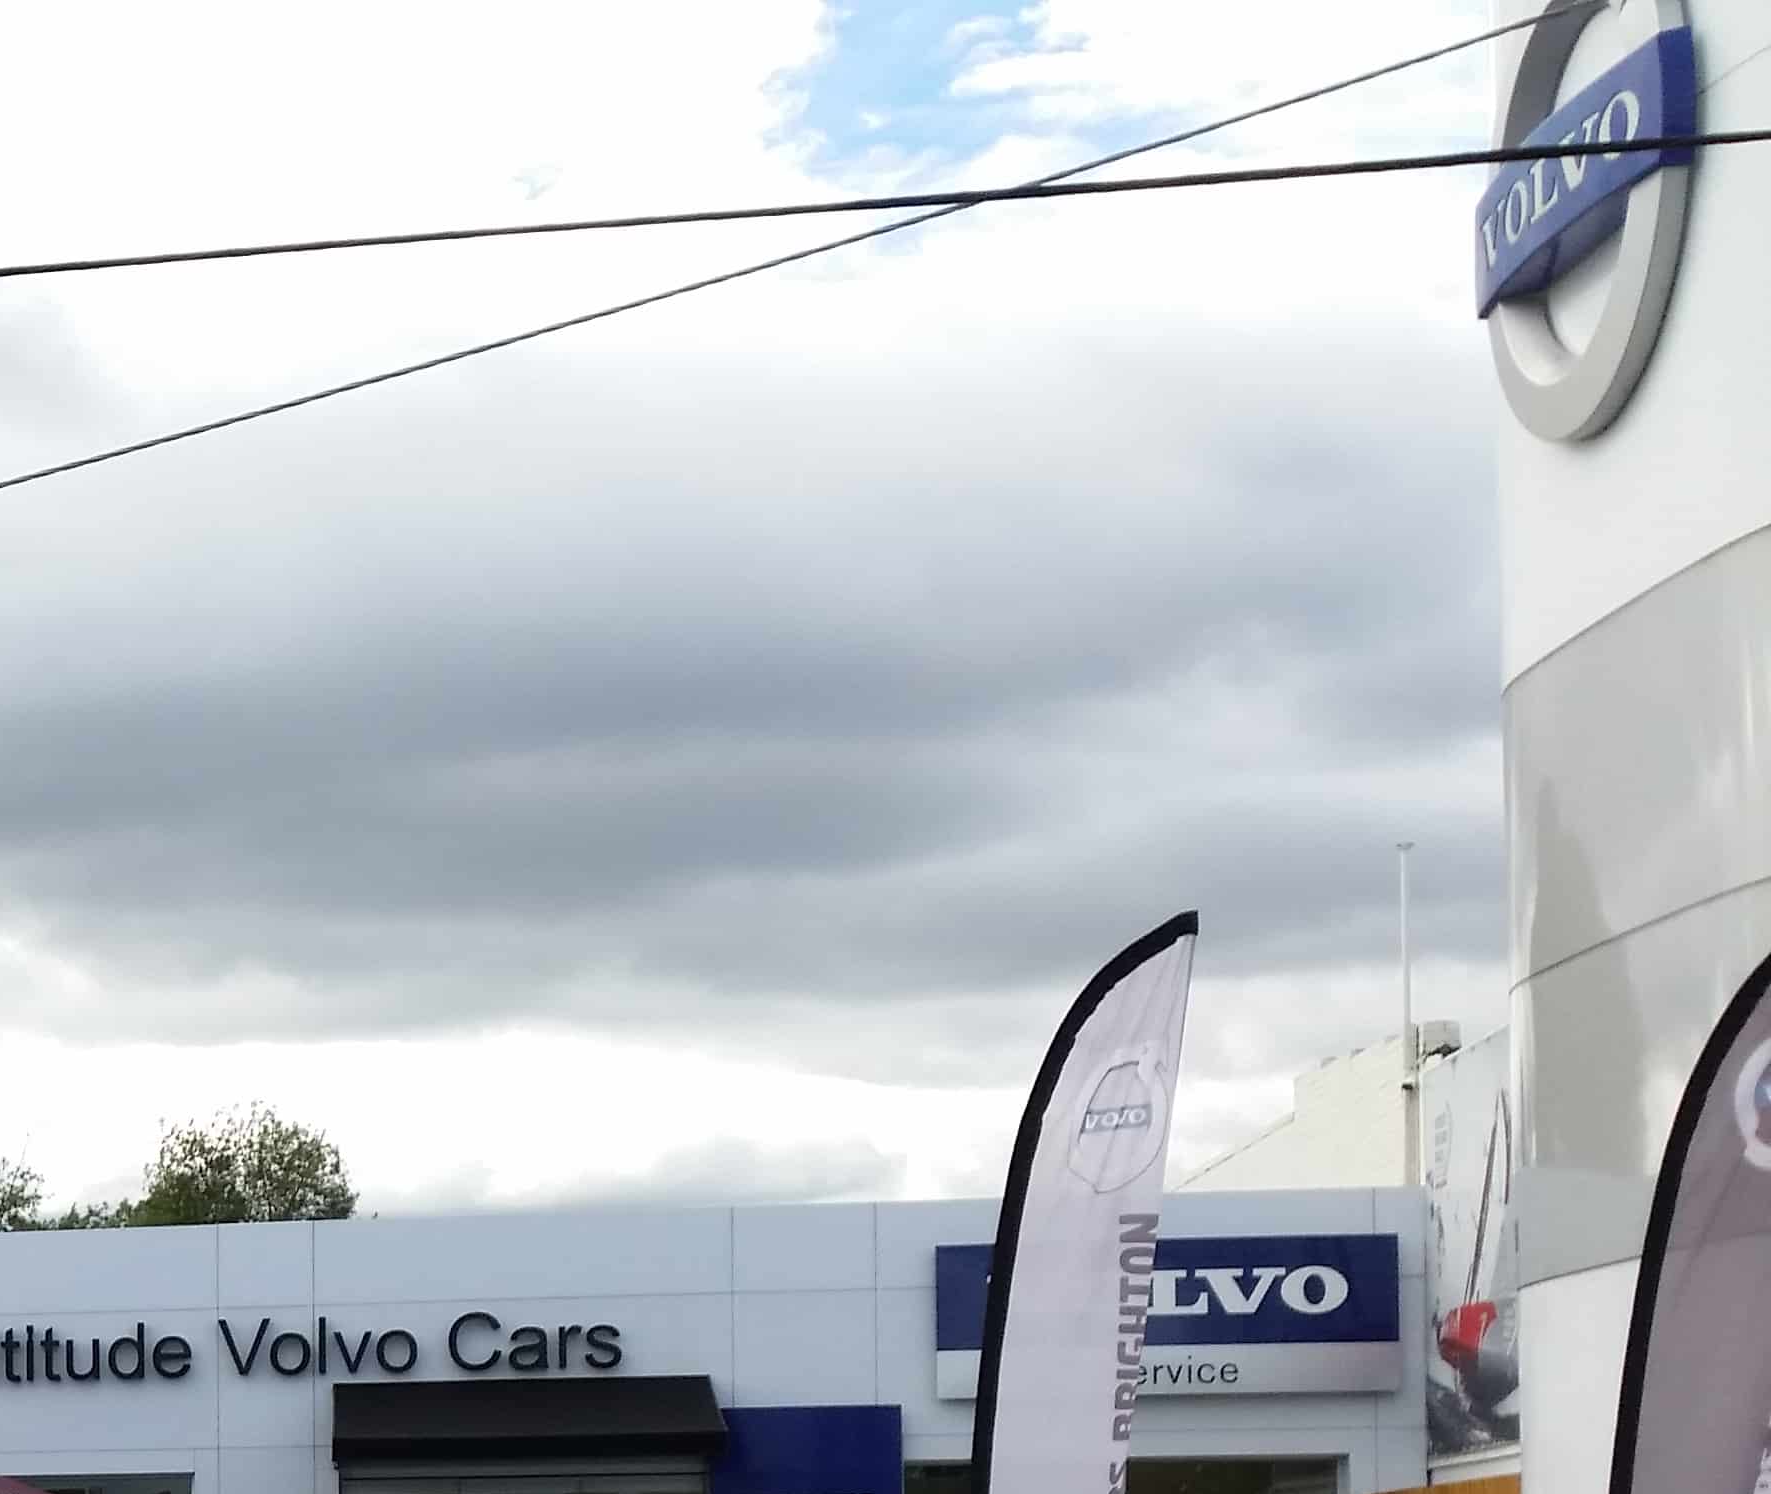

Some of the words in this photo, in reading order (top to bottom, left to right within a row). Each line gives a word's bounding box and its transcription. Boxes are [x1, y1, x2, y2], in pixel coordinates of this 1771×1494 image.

[1482, 90, 1641, 271] VOLVO
[1148, 1265, 1350, 1316] LVO
[218, 1316, 419, 1377] Volvo
[447, 1311, 624, 1371] Cars
[1137, 1355, 1239, 1386] ervice
